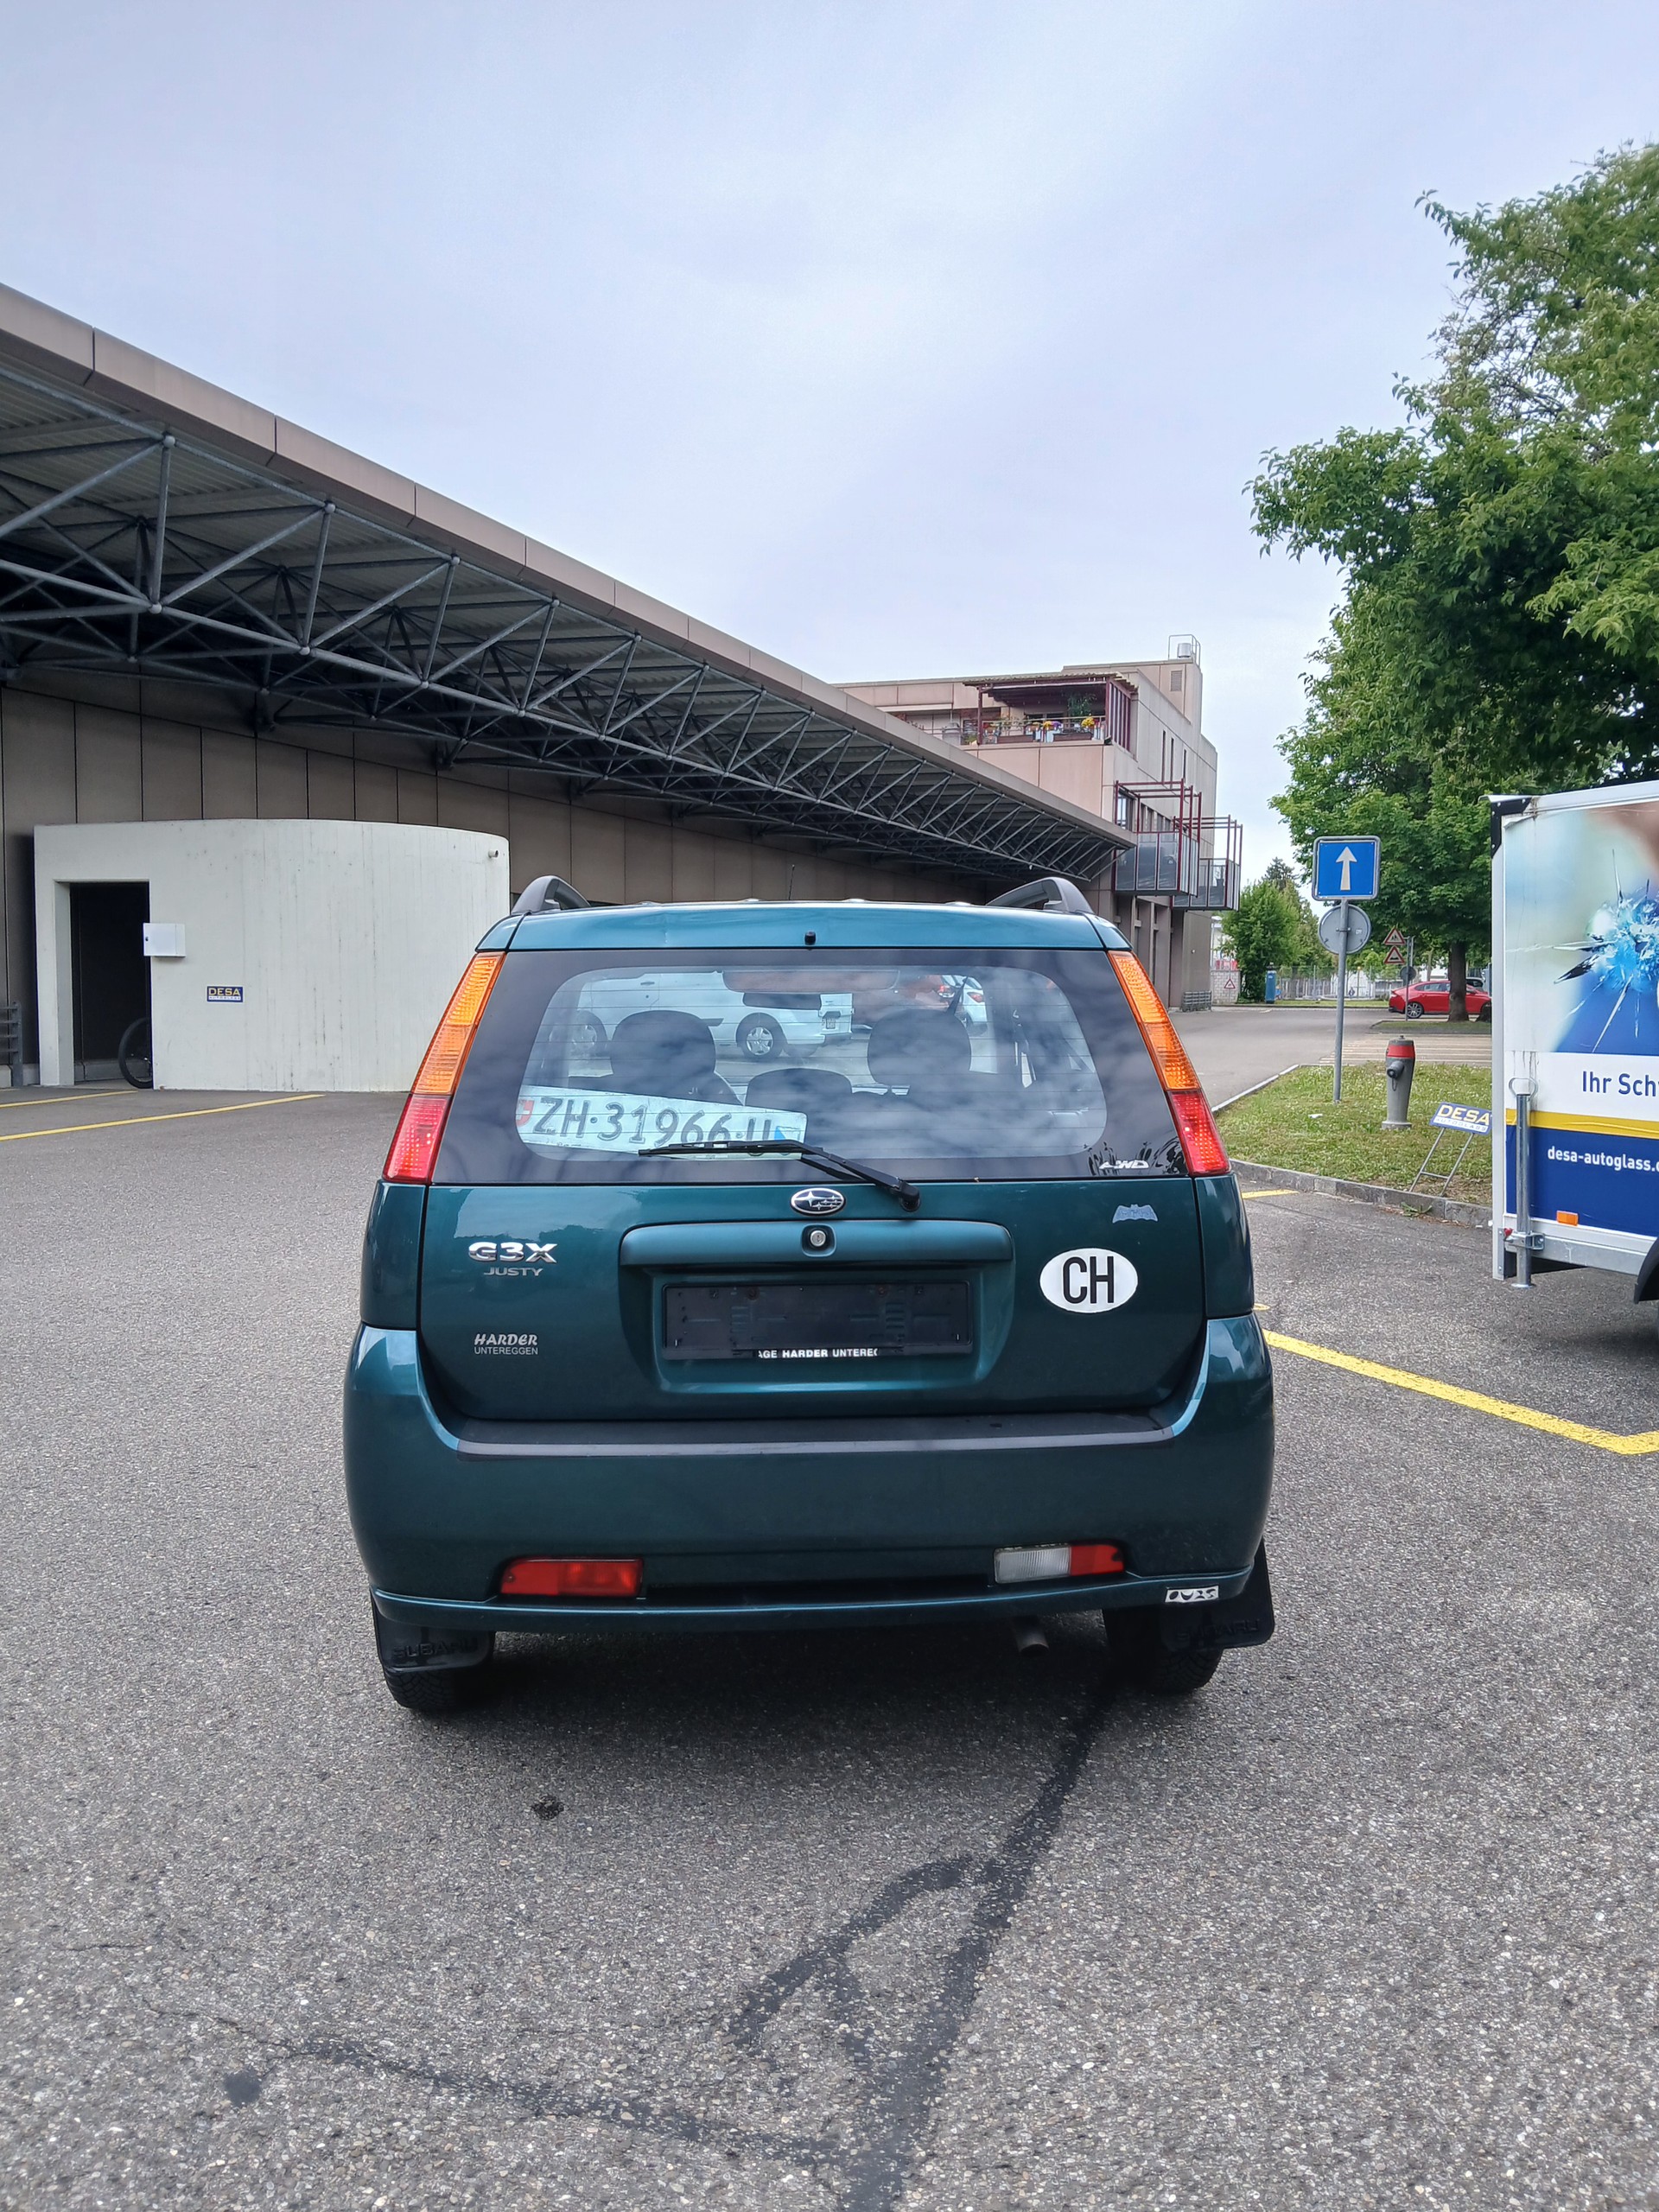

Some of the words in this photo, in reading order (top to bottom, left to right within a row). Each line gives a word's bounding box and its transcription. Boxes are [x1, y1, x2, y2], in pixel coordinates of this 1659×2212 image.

[208, 988, 240, 996] DESA
[1582, 1071, 1612, 1094] Ihr
[1618, 1073, 1659, 1097] Sch
[1437, 1104, 1490, 1126] DESA
[467, 1242, 558, 1263] G3X
[484, 1267, 543, 1276] JUSTY
[1063, 1256, 1115, 1304] CH
[474, 1333, 538, 1346] HARDER
[474, 1347, 538, 1356] UNTEREGGEN
[782, 1349, 829, 1358] HARDER
